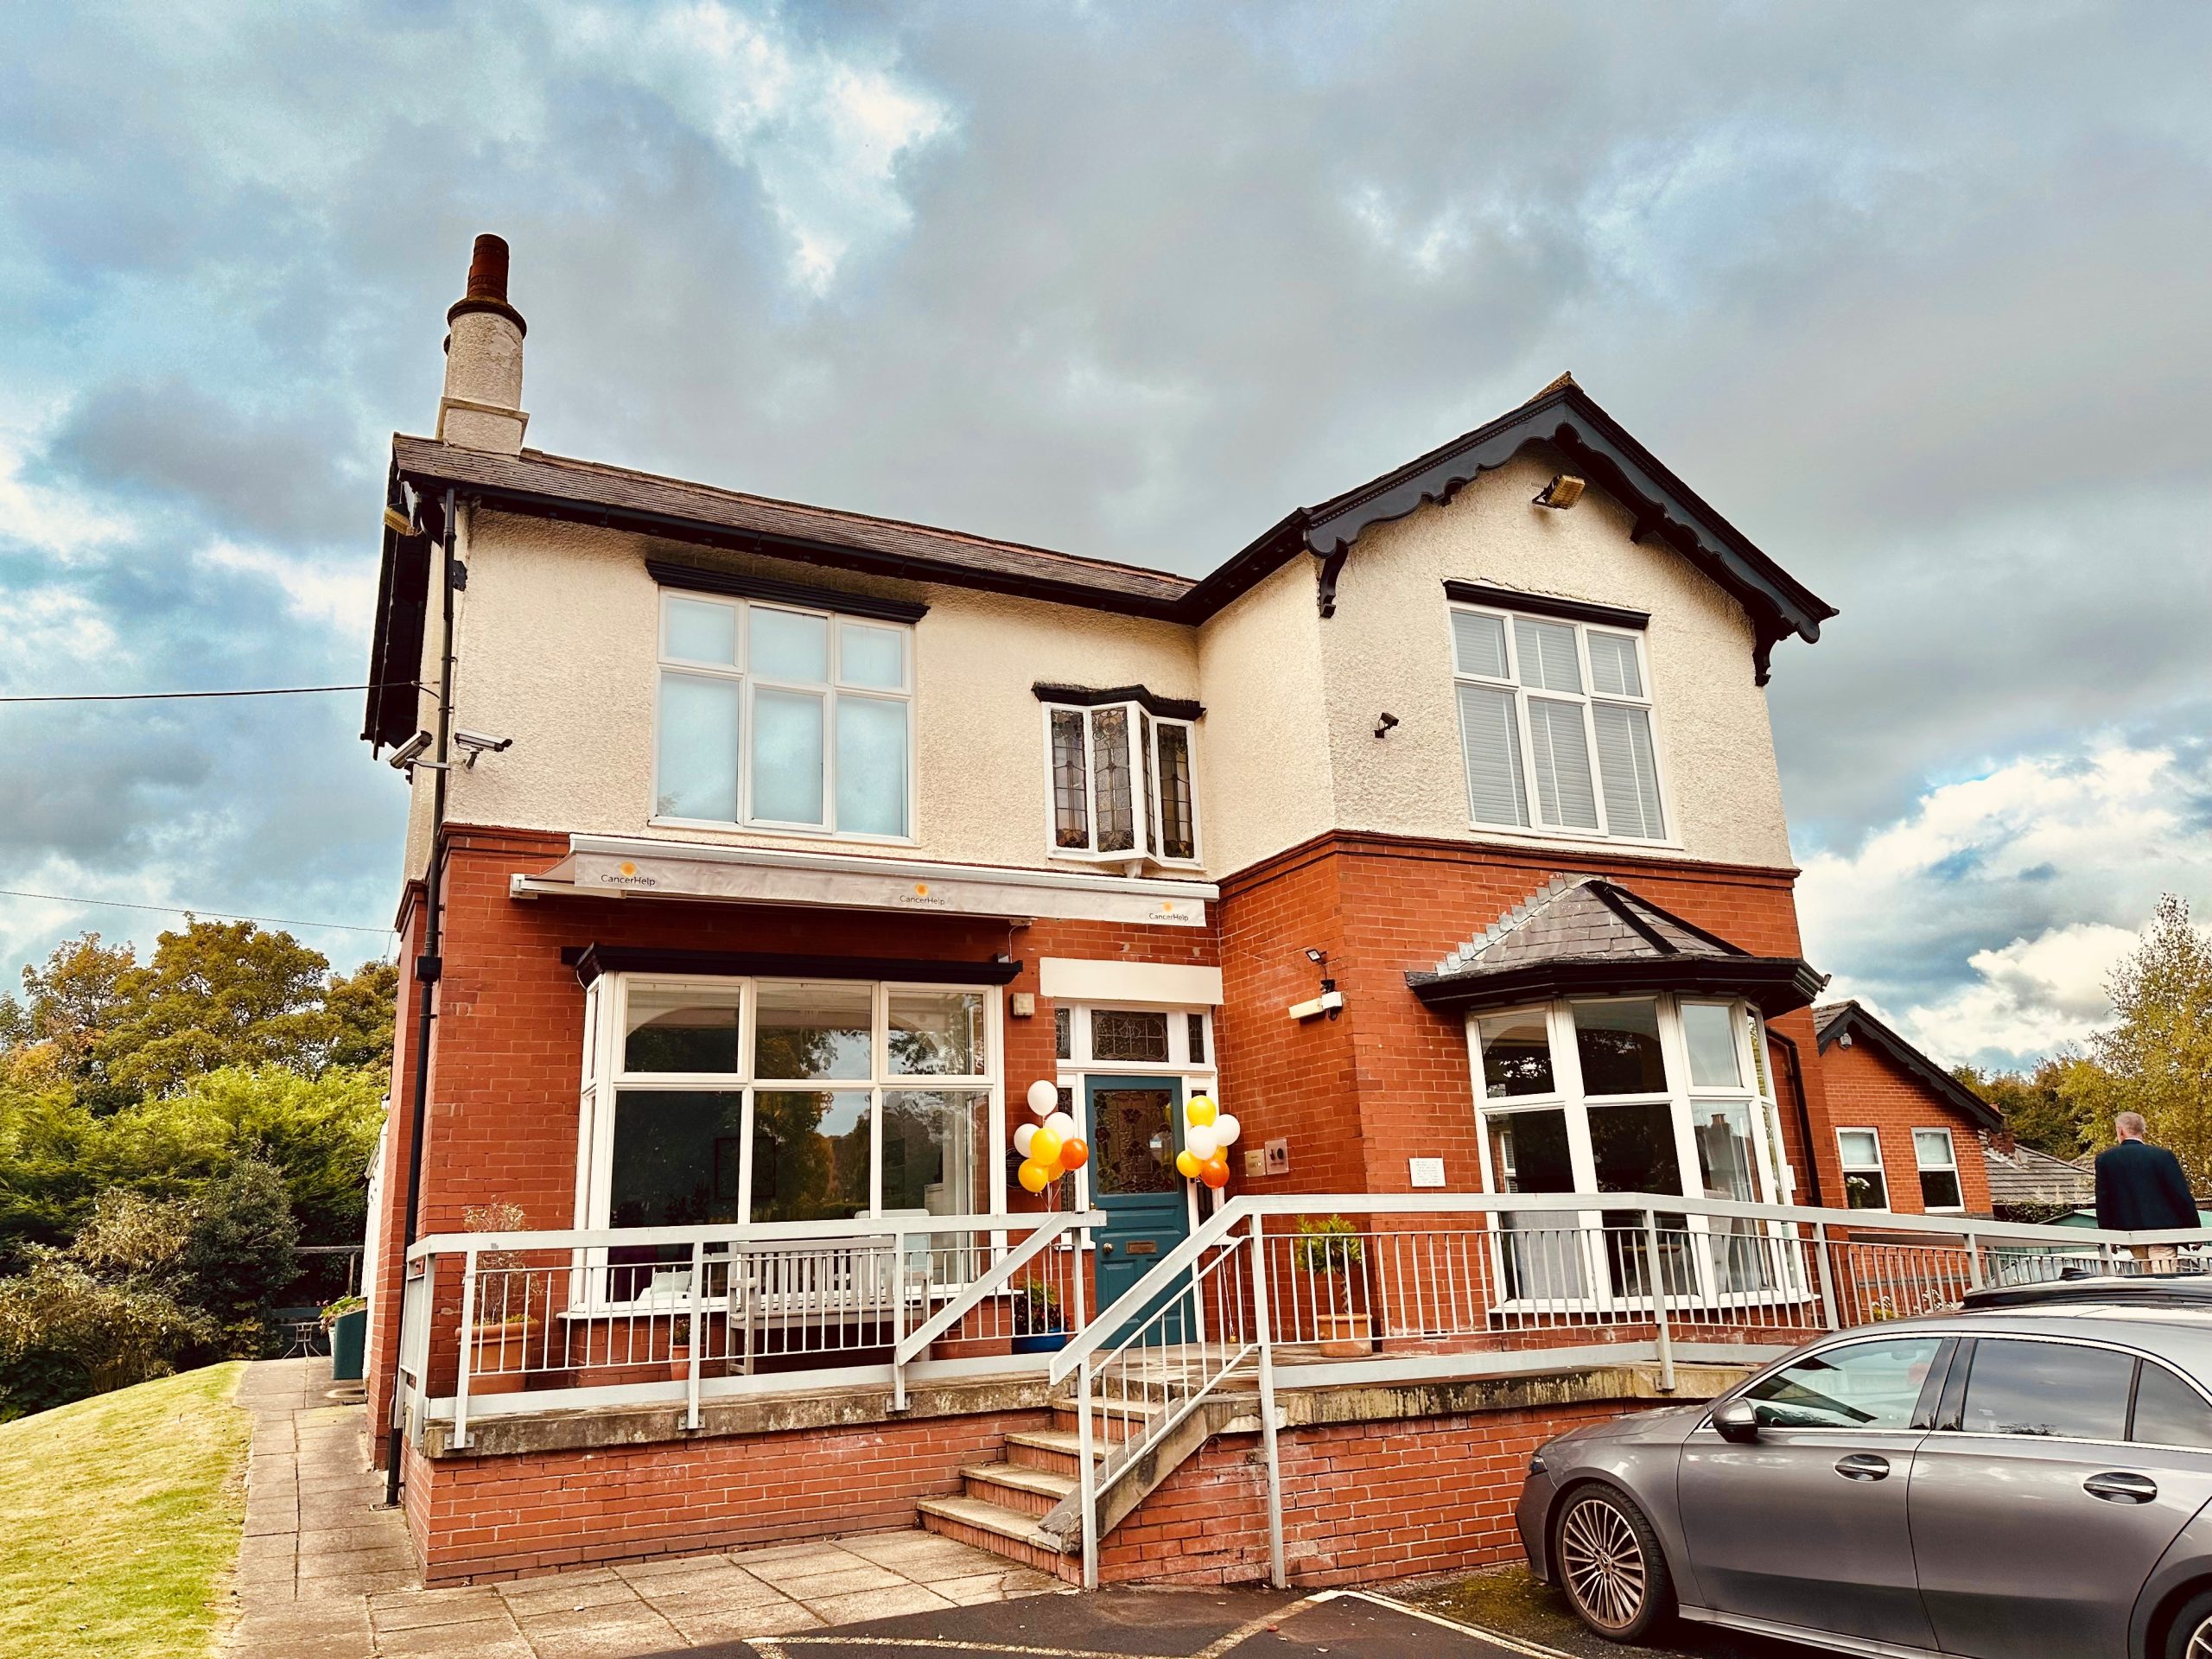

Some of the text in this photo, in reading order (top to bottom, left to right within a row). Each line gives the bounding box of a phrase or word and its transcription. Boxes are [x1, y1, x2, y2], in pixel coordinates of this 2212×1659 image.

[601, 874, 656, 887] CancerHelp
[899, 894, 945, 906] CancerHelp
[1148, 912, 1189, 922] CancerHelp
